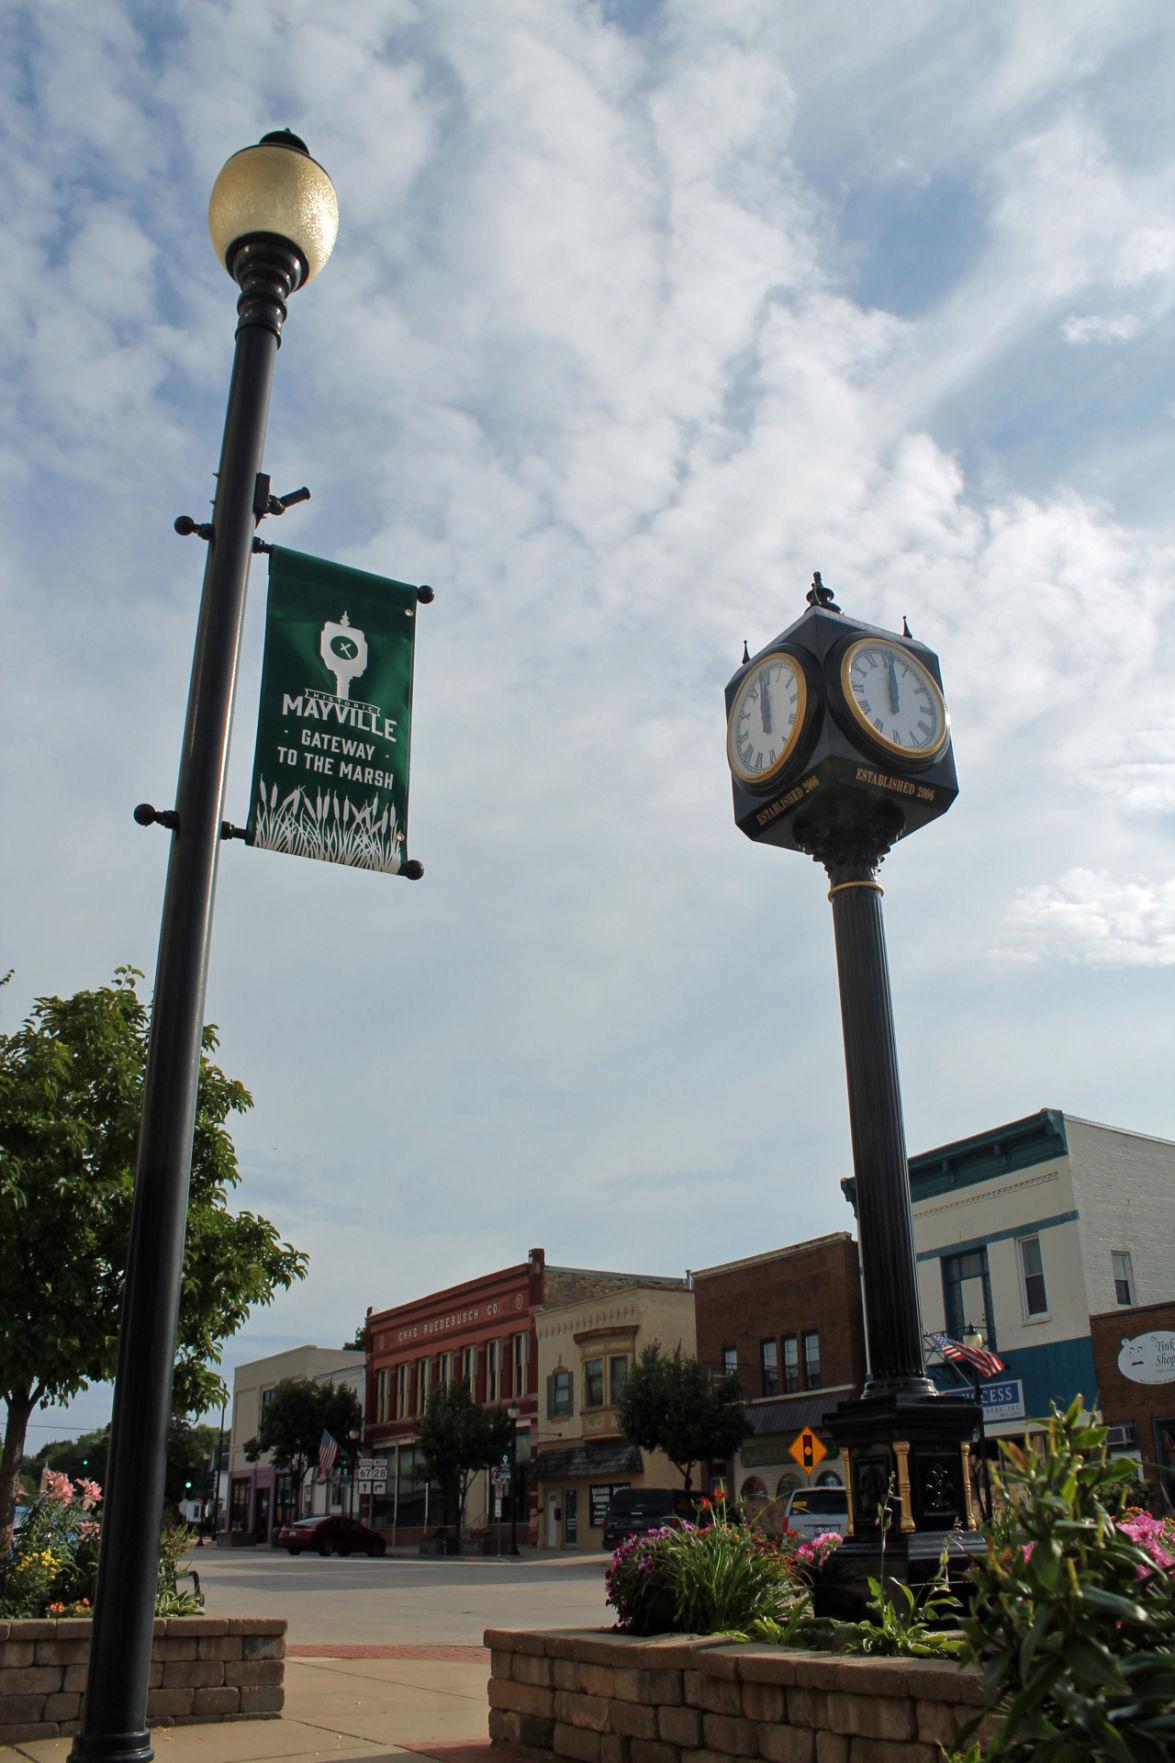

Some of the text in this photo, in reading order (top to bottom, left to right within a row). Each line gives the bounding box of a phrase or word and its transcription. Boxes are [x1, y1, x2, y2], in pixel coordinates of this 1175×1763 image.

[281, 693, 398, 743] MAYVILLE
[313, 692, 373, 711] HISTORIC
[301, 728, 376, 761] GATEWAY
[278, 746, 394, 790] TO THE MARSH
[855, 767, 936, 801] ESTABLISHED 2006
[756, 787, 803, 826] ESTABLISHED
[360, 1468, 371, 1478] 67
